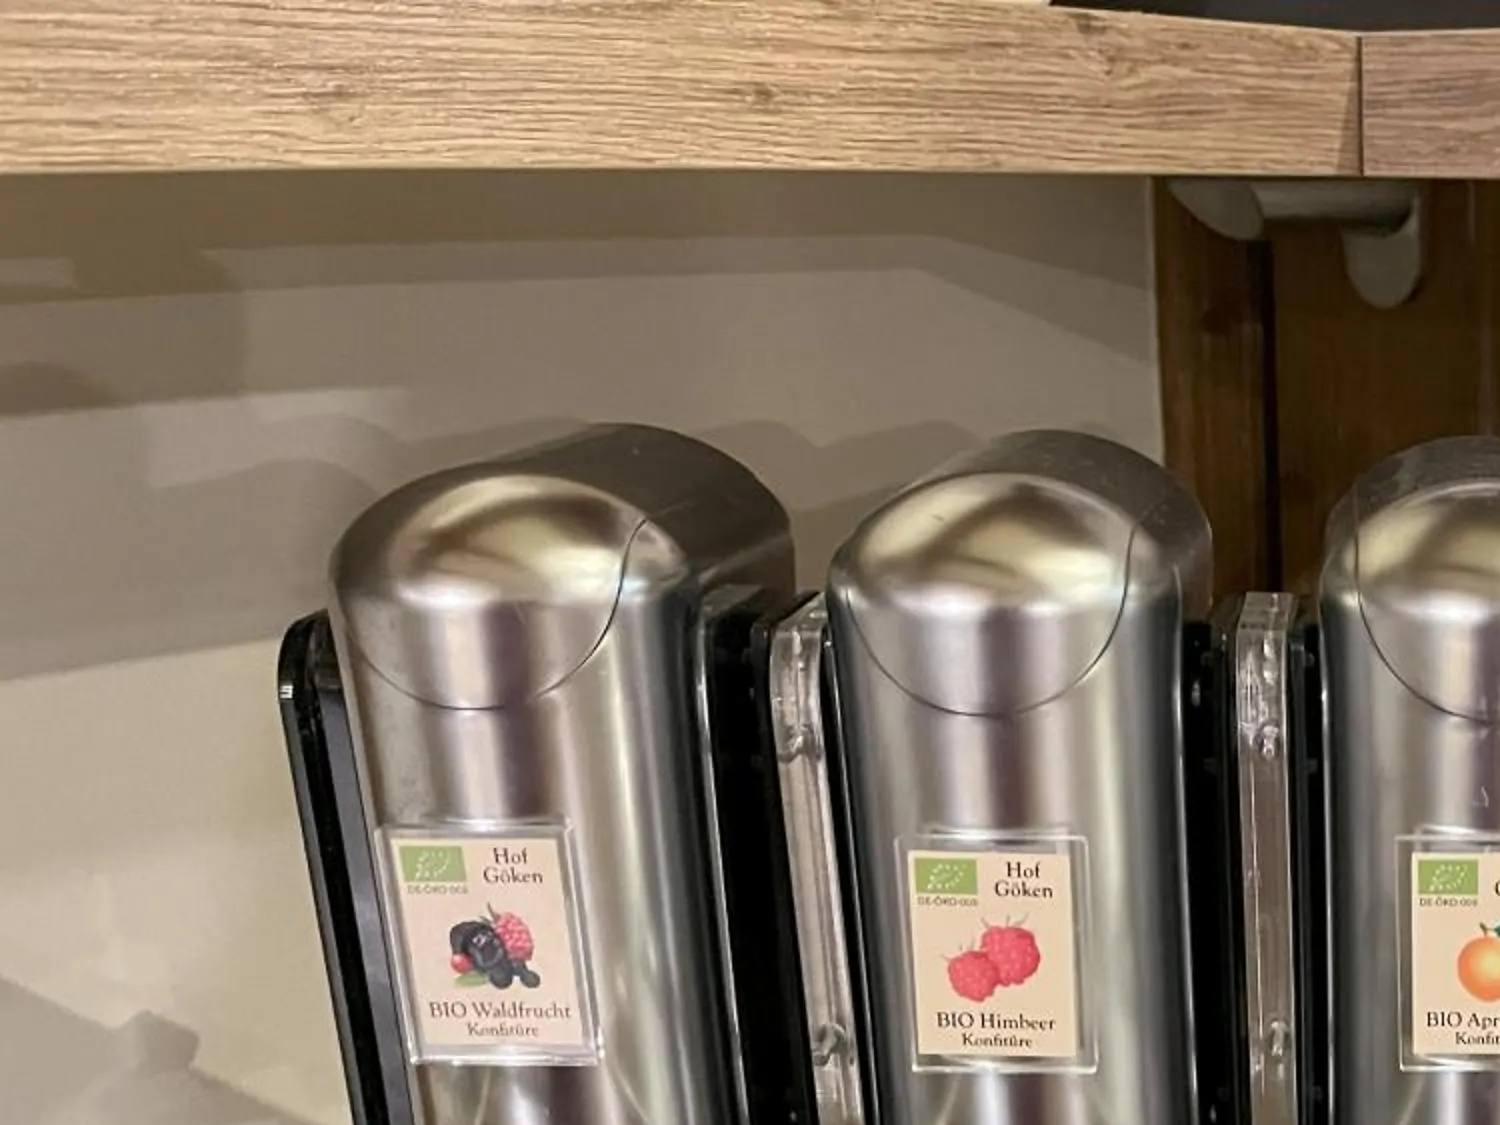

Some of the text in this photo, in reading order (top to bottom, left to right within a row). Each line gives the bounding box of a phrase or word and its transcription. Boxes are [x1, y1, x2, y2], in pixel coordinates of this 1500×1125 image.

[493, 847, 528, 864] Hof
[483, 867, 544, 885] Göken
[1006, 861, 1041, 879] Hof
[994, 881, 1054, 899] Göken
[430, 1001, 572, 1019] BIO Waldfrucht
[937, 1012, 1056, 1031] BIO Himbeer
[1427, 1011, 1462, 1028] BIO
[467, 1023, 540, 1037] Konfitüre
[962, 1033, 1032, 1048] Konfitüre
